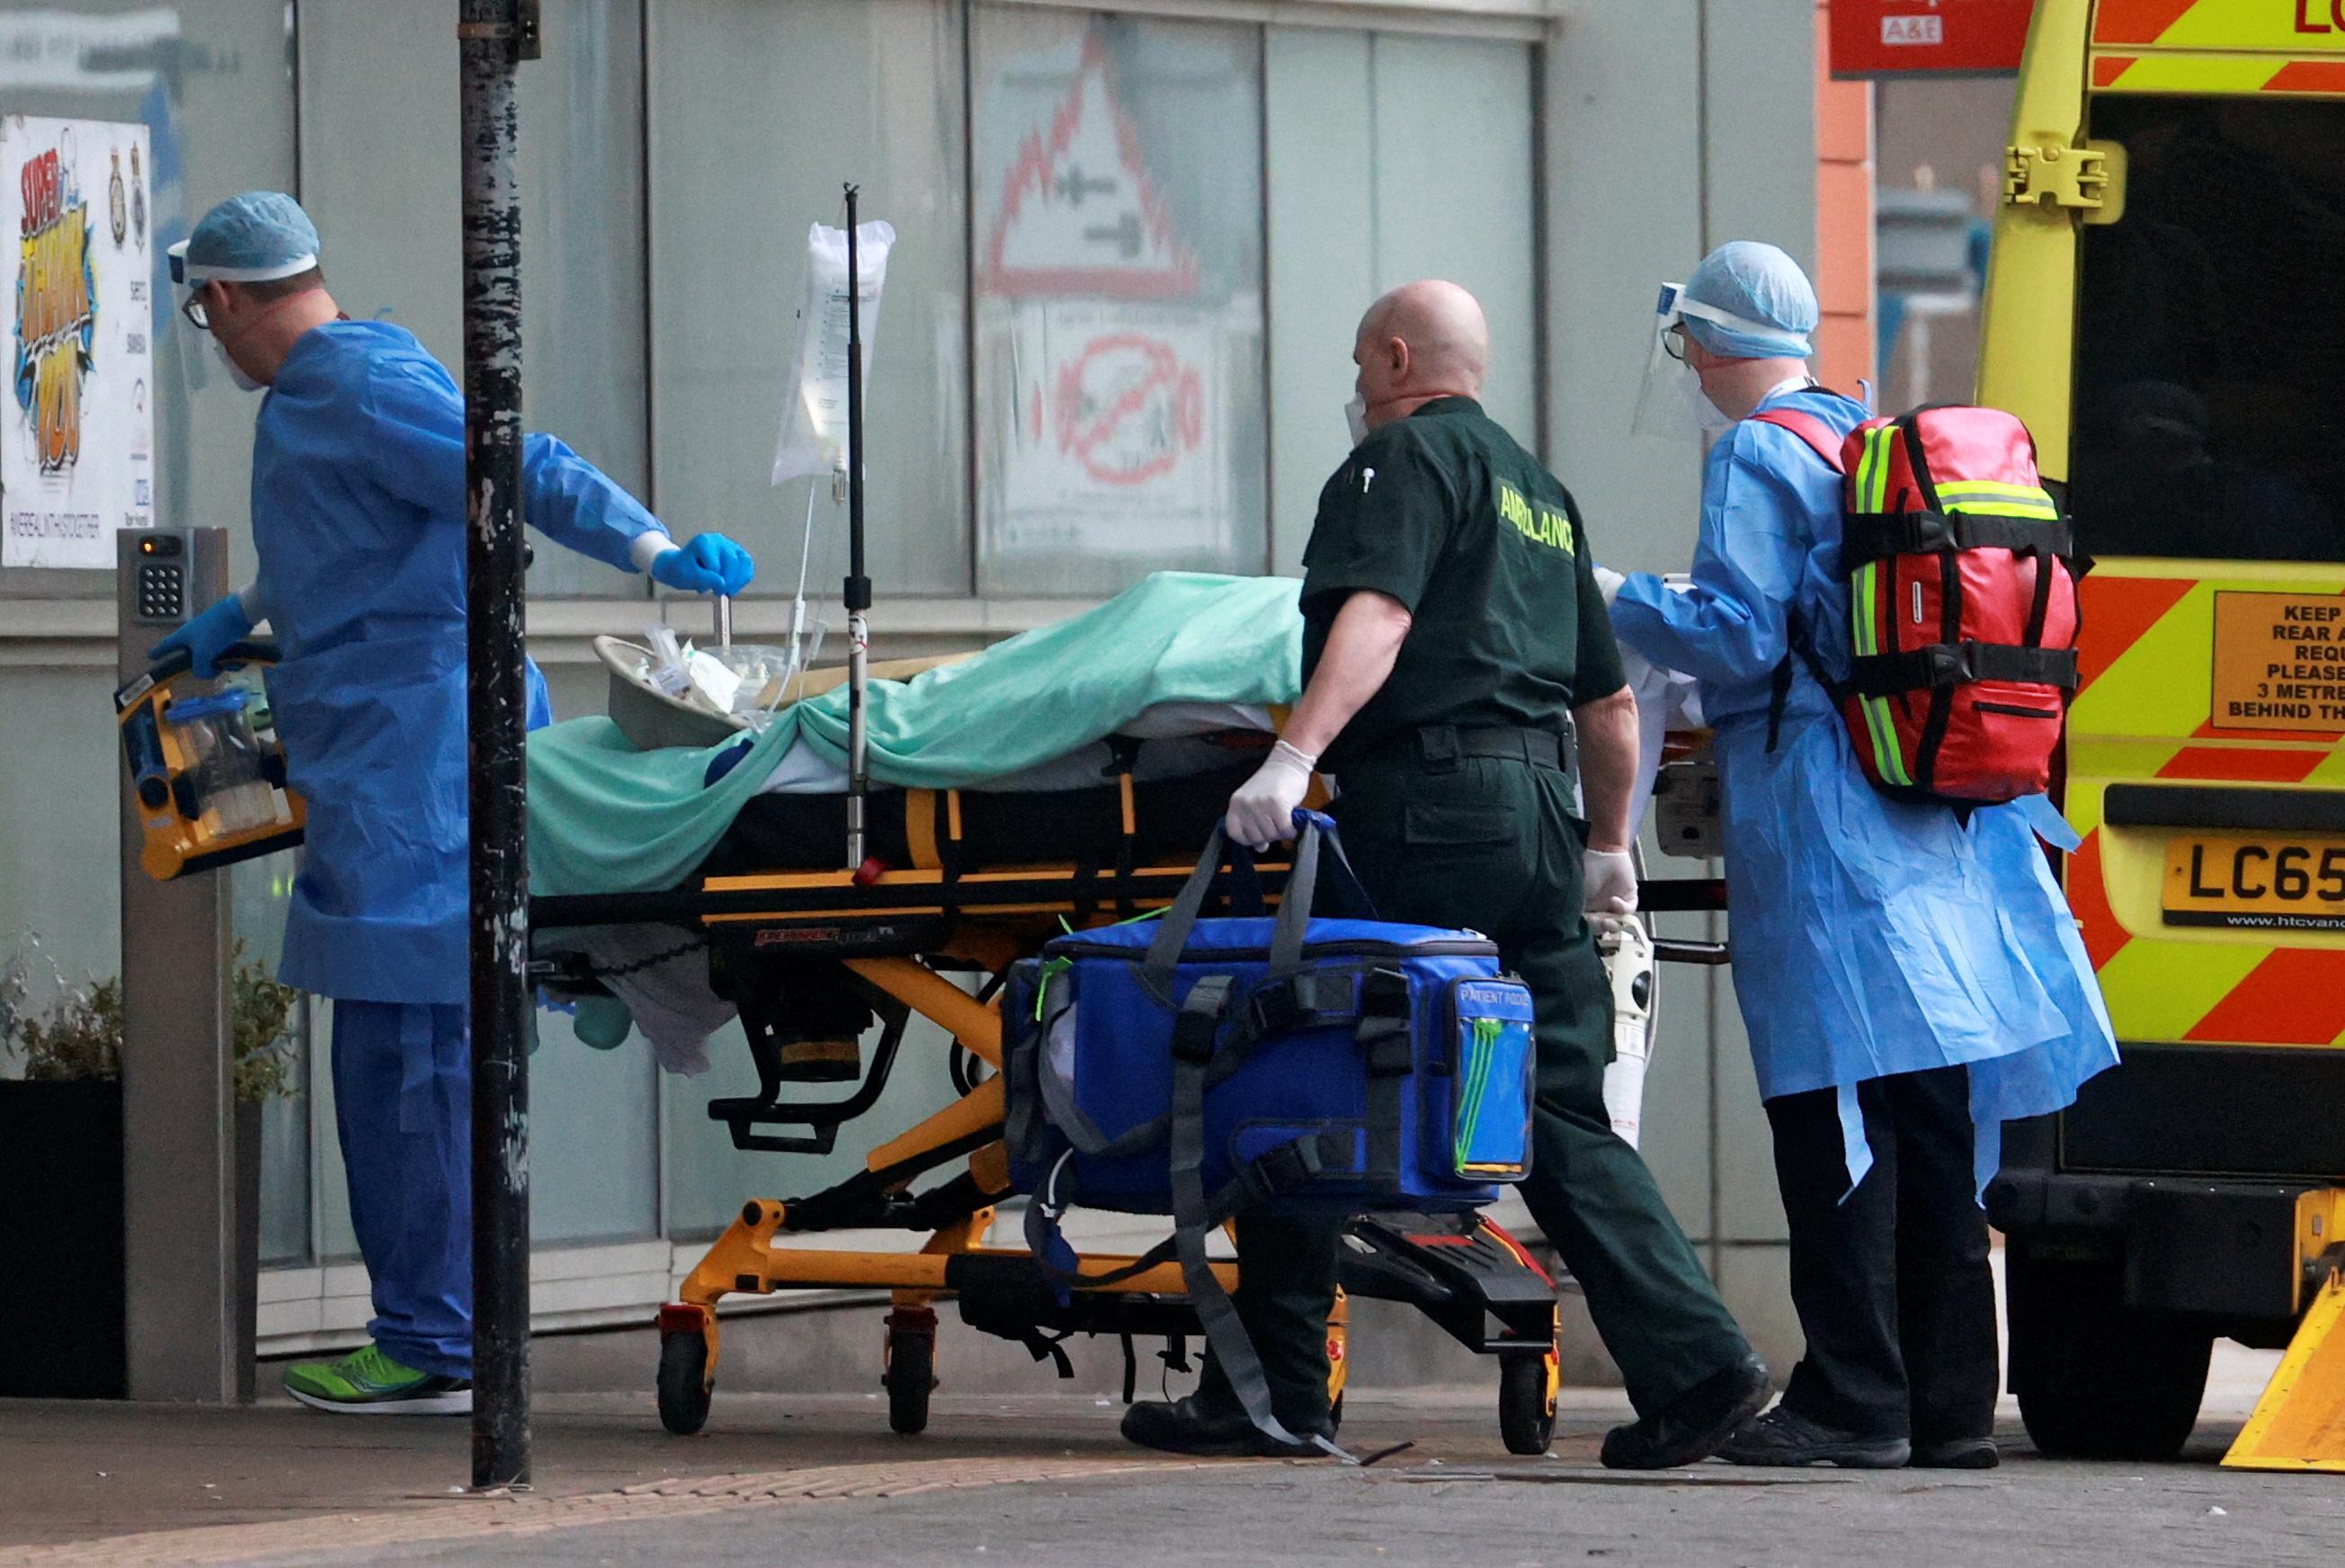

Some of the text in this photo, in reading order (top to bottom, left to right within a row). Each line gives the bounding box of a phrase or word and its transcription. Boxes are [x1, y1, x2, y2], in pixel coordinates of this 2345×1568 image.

[1885, 17, 1939, 40] A&E
[2285, 605, 2341, 621] KEEP
[2273, 625, 2331, 641] REAR
[2268, 664, 2345, 681] PLEASE
[2257, 682, 2269, 699] 3
[2229, 701, 2311, 719] BEHIND
[2189, 844, 2345, 901] LC65
[1460, 990, 1503, 1004] PATIENT
